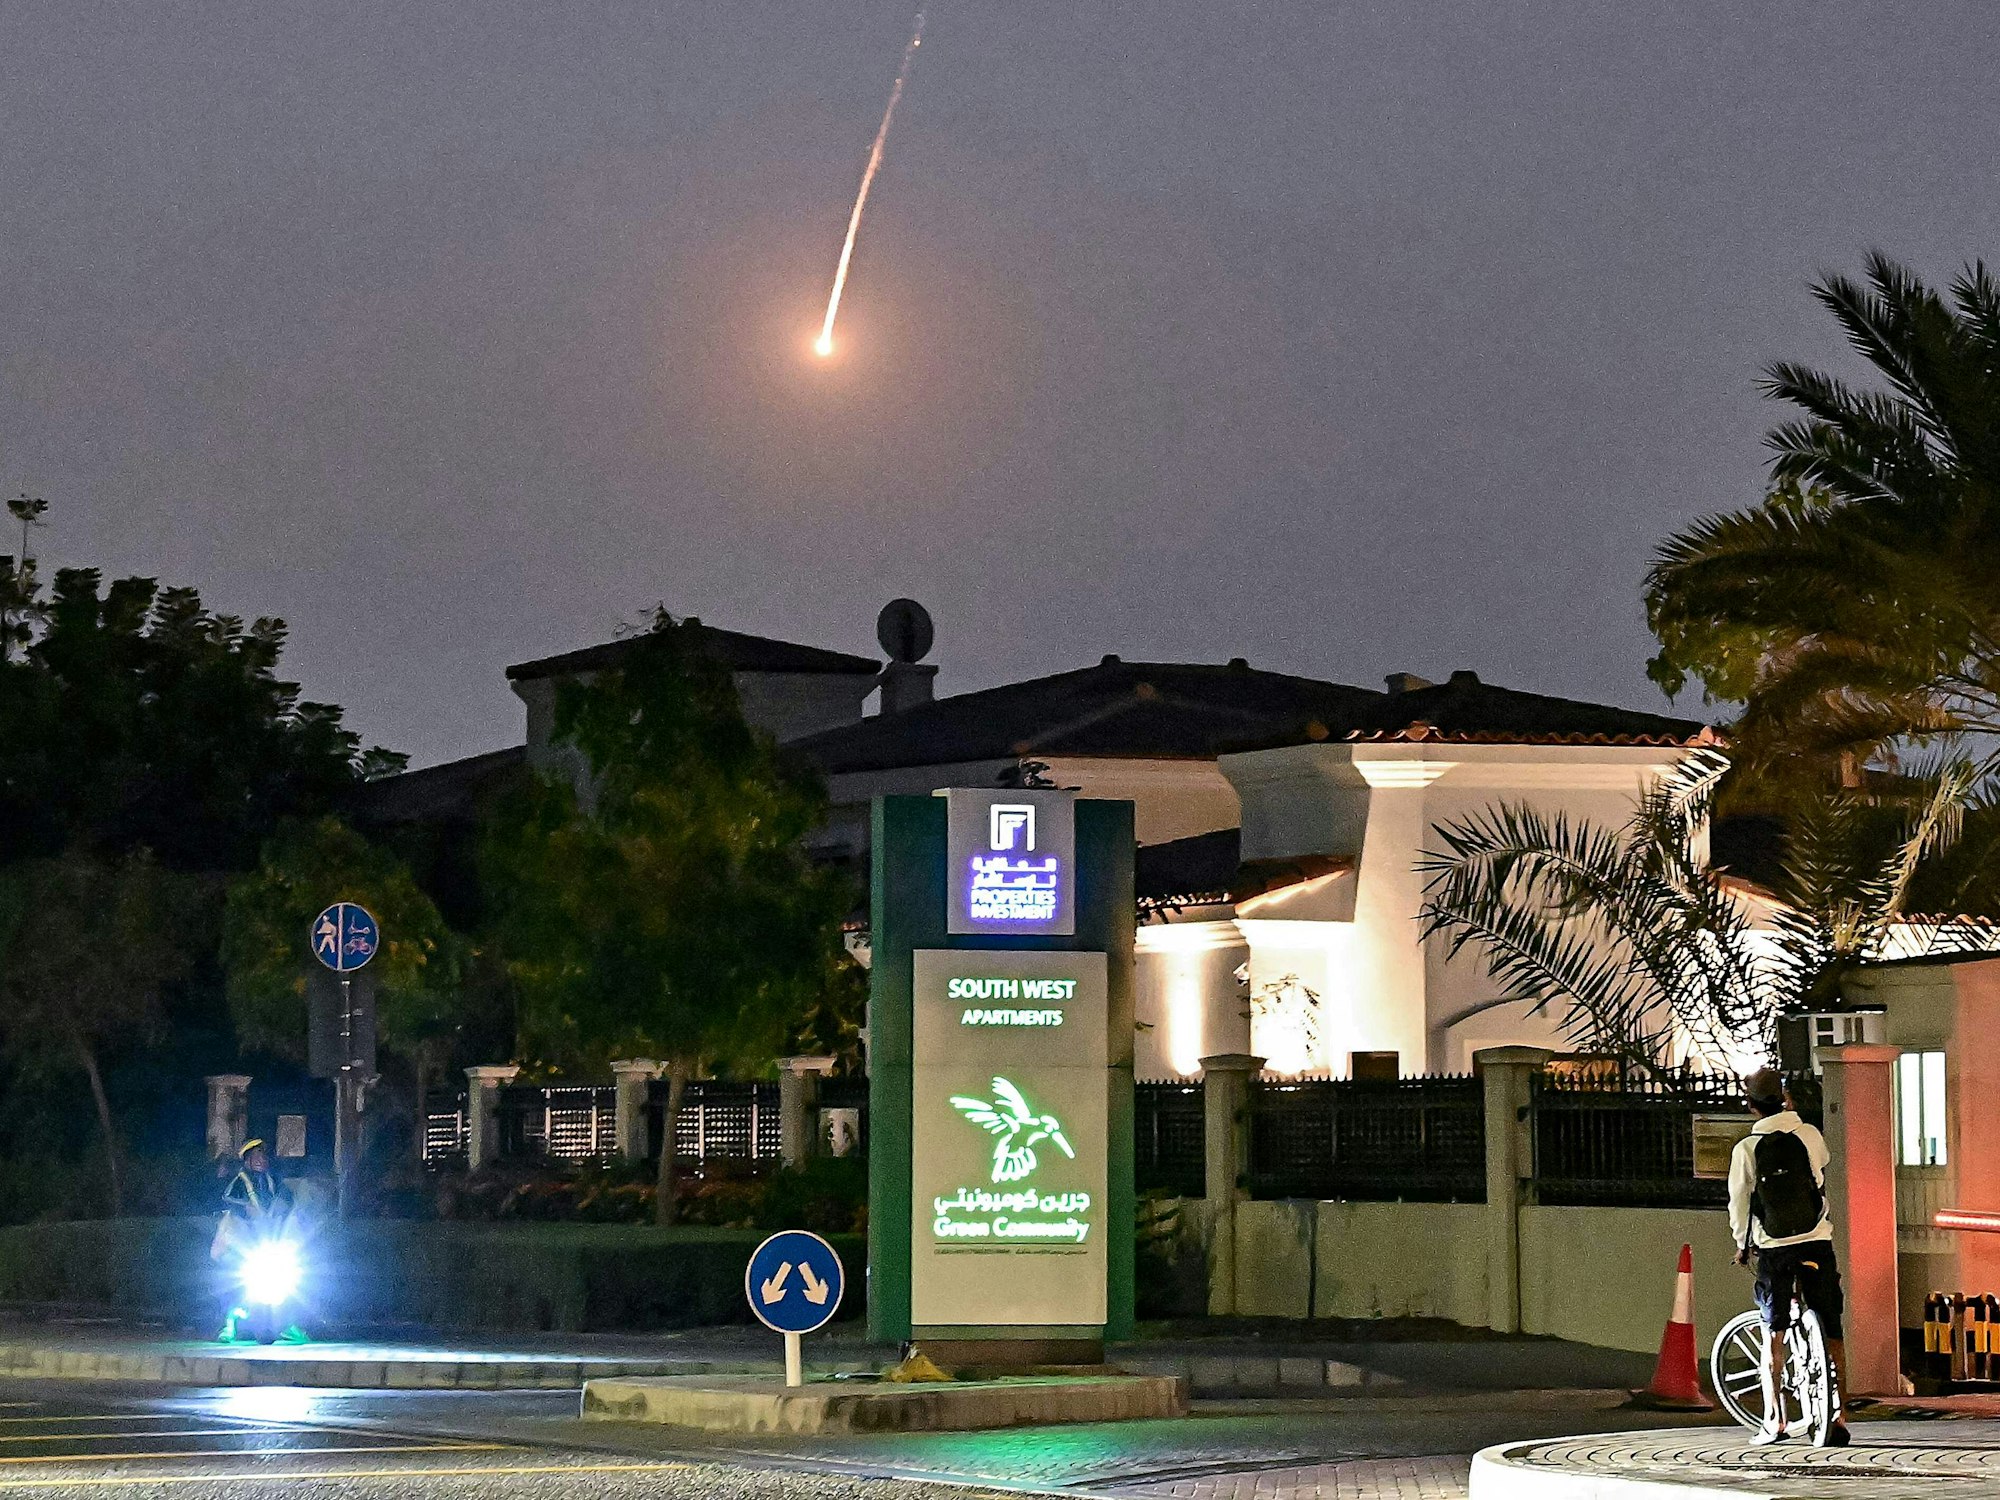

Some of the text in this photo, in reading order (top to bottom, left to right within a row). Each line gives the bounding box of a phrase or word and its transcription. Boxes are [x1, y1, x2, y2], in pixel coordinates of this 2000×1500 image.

[971, 888, 1056, 904] PROPERTIES
[971, 904, 1055, 919] INVESTMENT
[948, 978, 1077, 999] SOUTH WEST
[961, 1009, 1063, 1026] APARTMENTS
[933, 1187, 1090, 1216] جرين كوميونيتي
[933, 1216, 1090, 1242] Green Community
